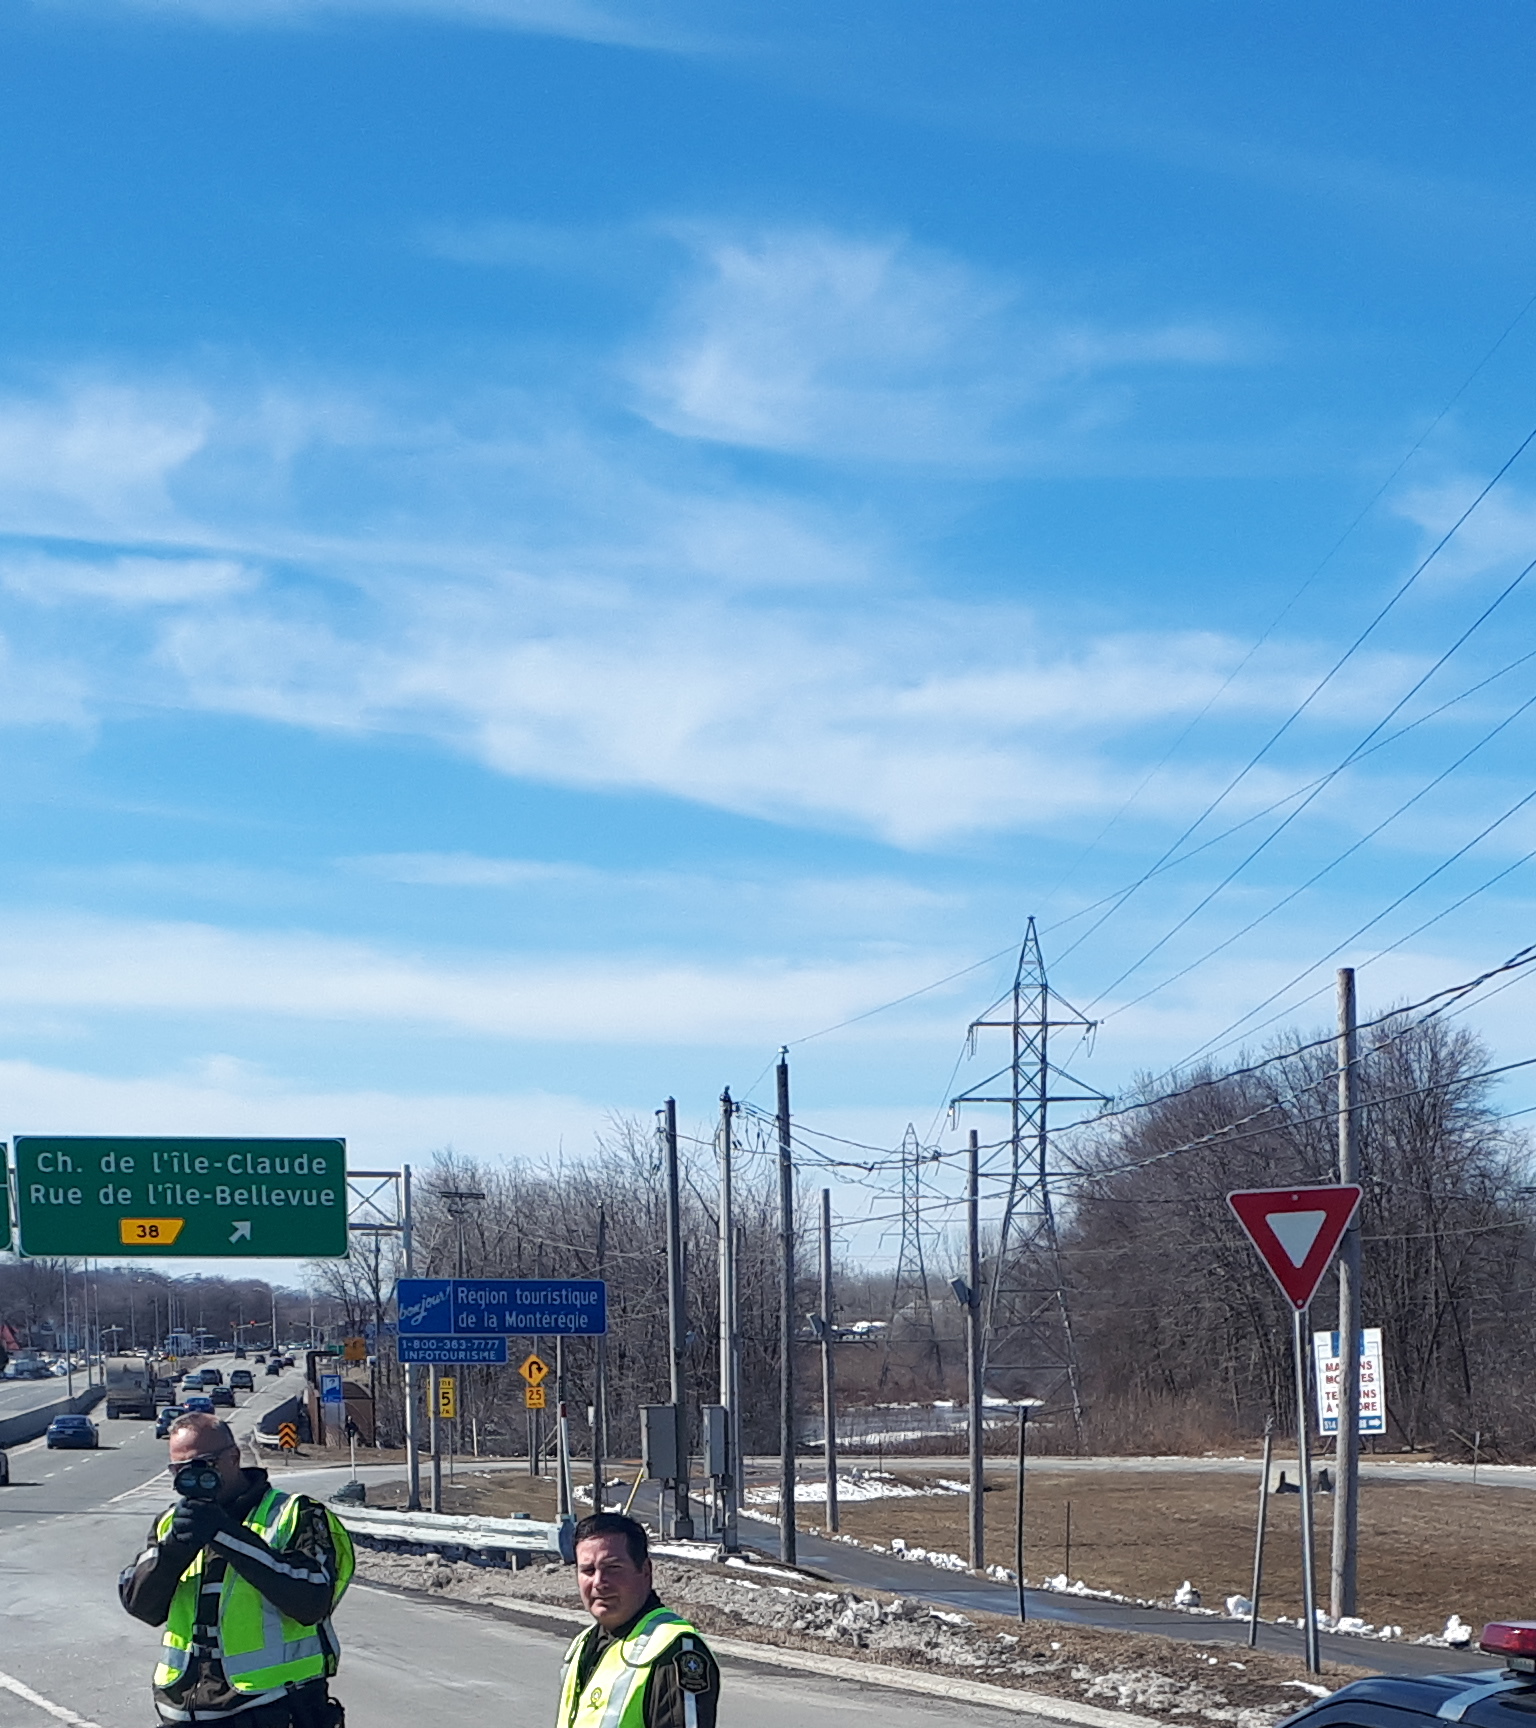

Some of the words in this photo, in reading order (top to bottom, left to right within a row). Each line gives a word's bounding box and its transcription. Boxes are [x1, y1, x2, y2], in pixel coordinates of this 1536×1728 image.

[36, 1152, 83, 1173] Ch.
[100, 1152, 135, 1174] de
[152, 1151, 327, 1175] l'île-Claude
[29, 1183, 82, 1205] Rue
[98, 1183, 132, 1205] de
[147, 1183, 335, 1206] l'île-Bellevue
[135, 1225, 160, 1239] 38
[457, 1286, 508, 1309] Région
[515, 1287, 598, 1309] touristique
[457, 1311, 477, 1328] de
[483, 1311, 498, 1328] la
[504, 1310, 589, 1333] Montérégie
[401, 1339, 500, 1350] 1-800-363-7777
[404, 1350, 497, 1360] INFOTOURISME
[528, 1389, 542, 1401] 25
